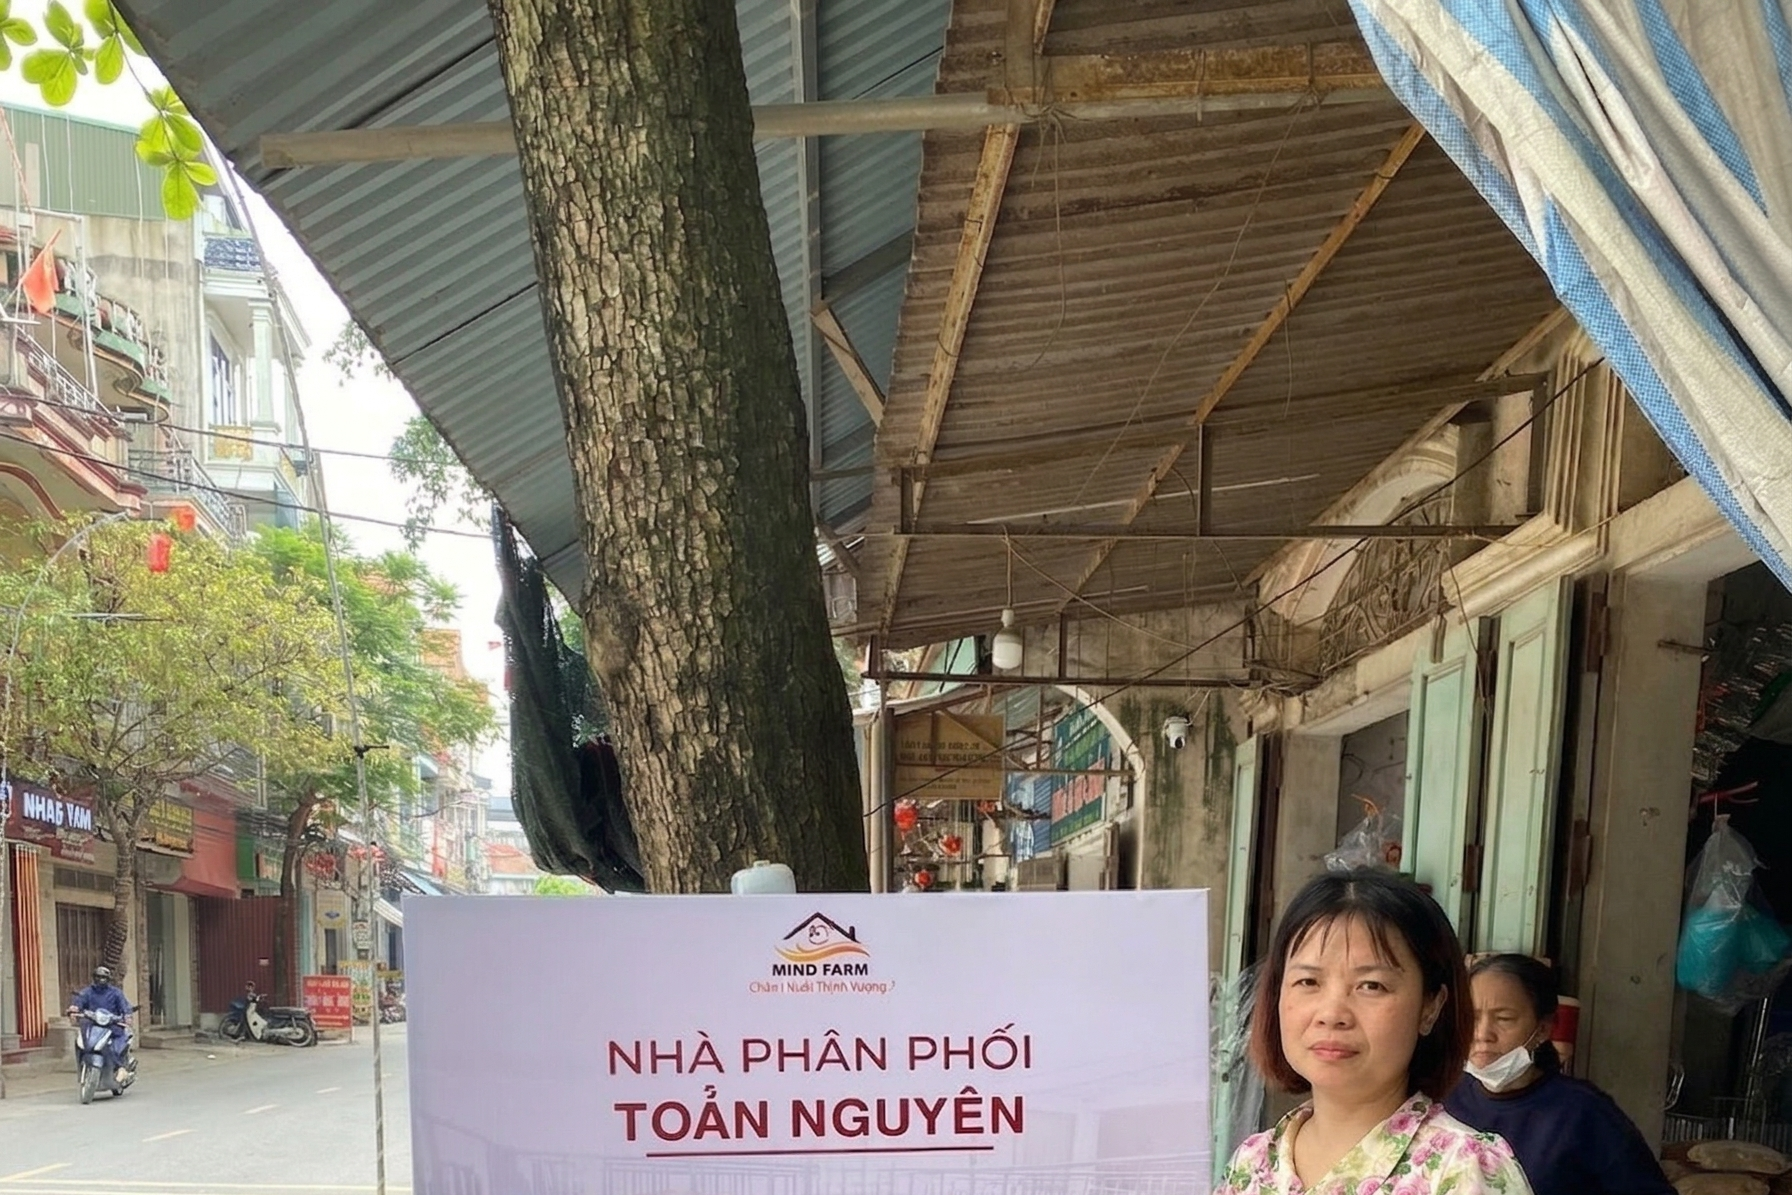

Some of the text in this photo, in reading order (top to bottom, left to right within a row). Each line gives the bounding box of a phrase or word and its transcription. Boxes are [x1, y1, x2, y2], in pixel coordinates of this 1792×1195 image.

[772, 963, 868, 976] MIND FARM
[608, 1023, 1031, 1075] NHÀ PHÂN PHỐI
[792, 1086, 1024, 1138] NGUYÊN
